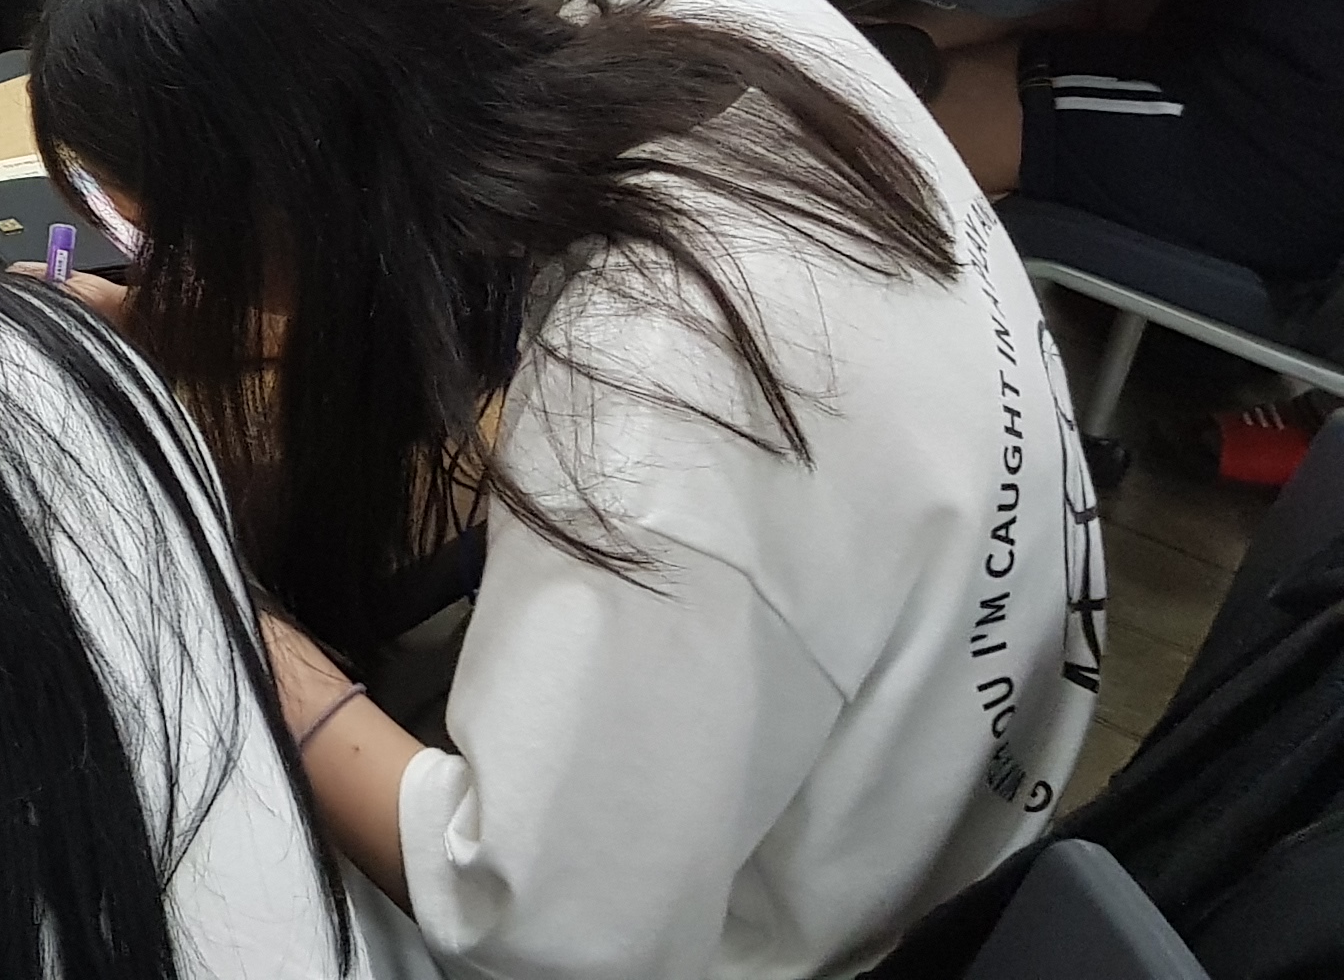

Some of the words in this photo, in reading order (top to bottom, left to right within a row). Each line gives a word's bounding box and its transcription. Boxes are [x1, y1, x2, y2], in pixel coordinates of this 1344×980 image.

[990, 314, 1018, 367] IN
[985, 369, 1024, 579] CAUGHT
[970, 591, 1011, 658] I'M
